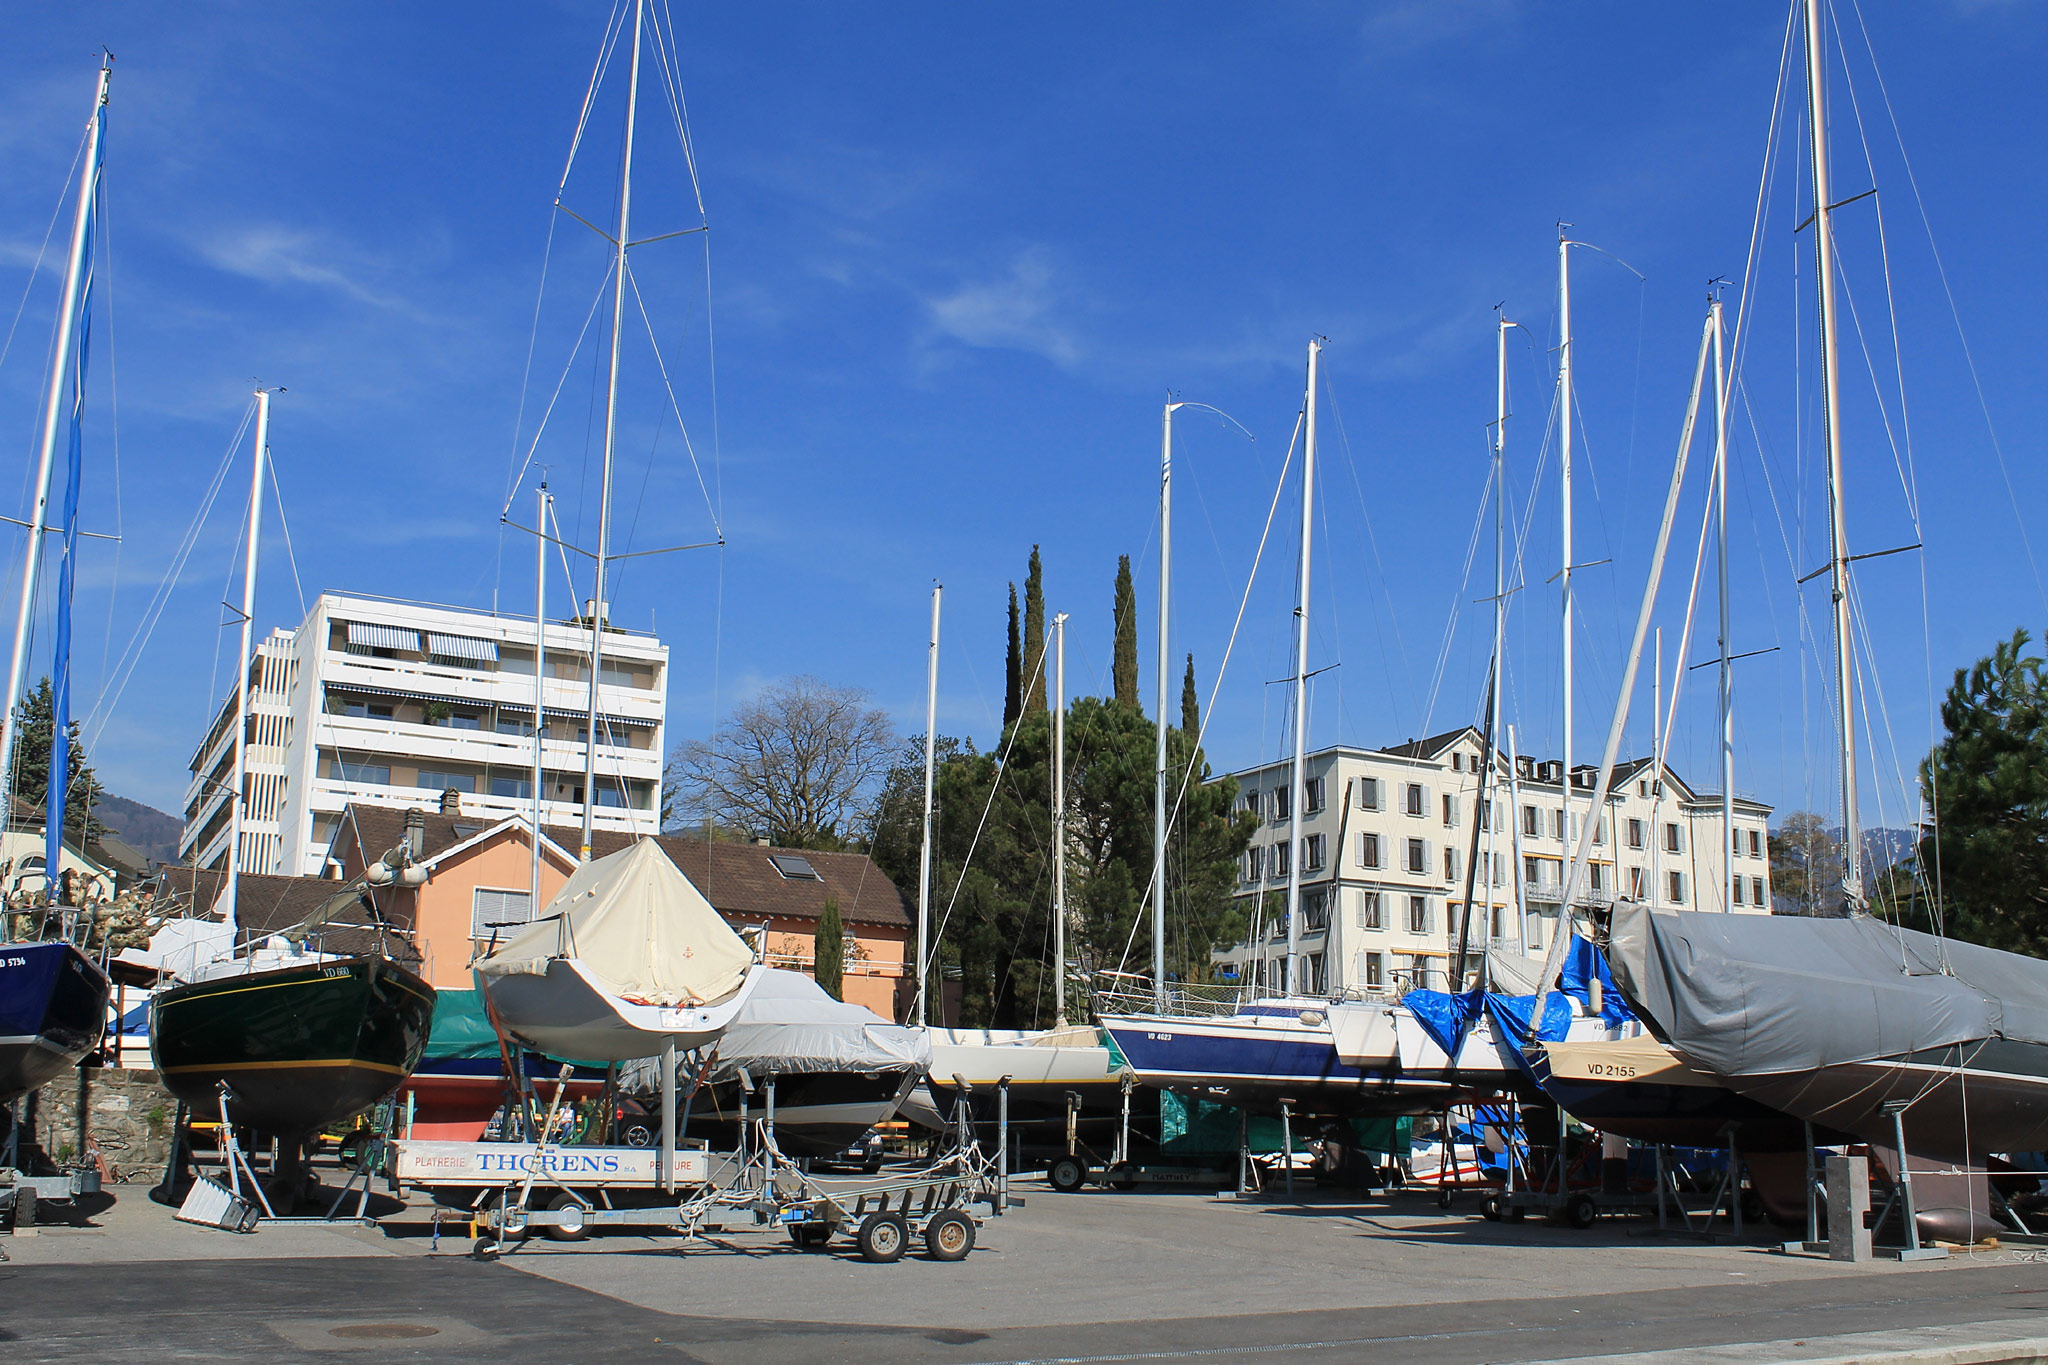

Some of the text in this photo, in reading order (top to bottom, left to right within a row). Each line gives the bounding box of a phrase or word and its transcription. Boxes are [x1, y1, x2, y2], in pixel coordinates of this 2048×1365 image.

[8, 957, 26, 967] 5736
[323, 968, 336, 977] VD
[1147, 1031, 1156, 1040] VD
[1587, 1063, 1636, 1077] VD 2155
[415, 1156, 465, 1168] PLATRERIE
[475, 1153, 620, 1172] THORENS
[649, 1160, 693, 1171] PEIURE
